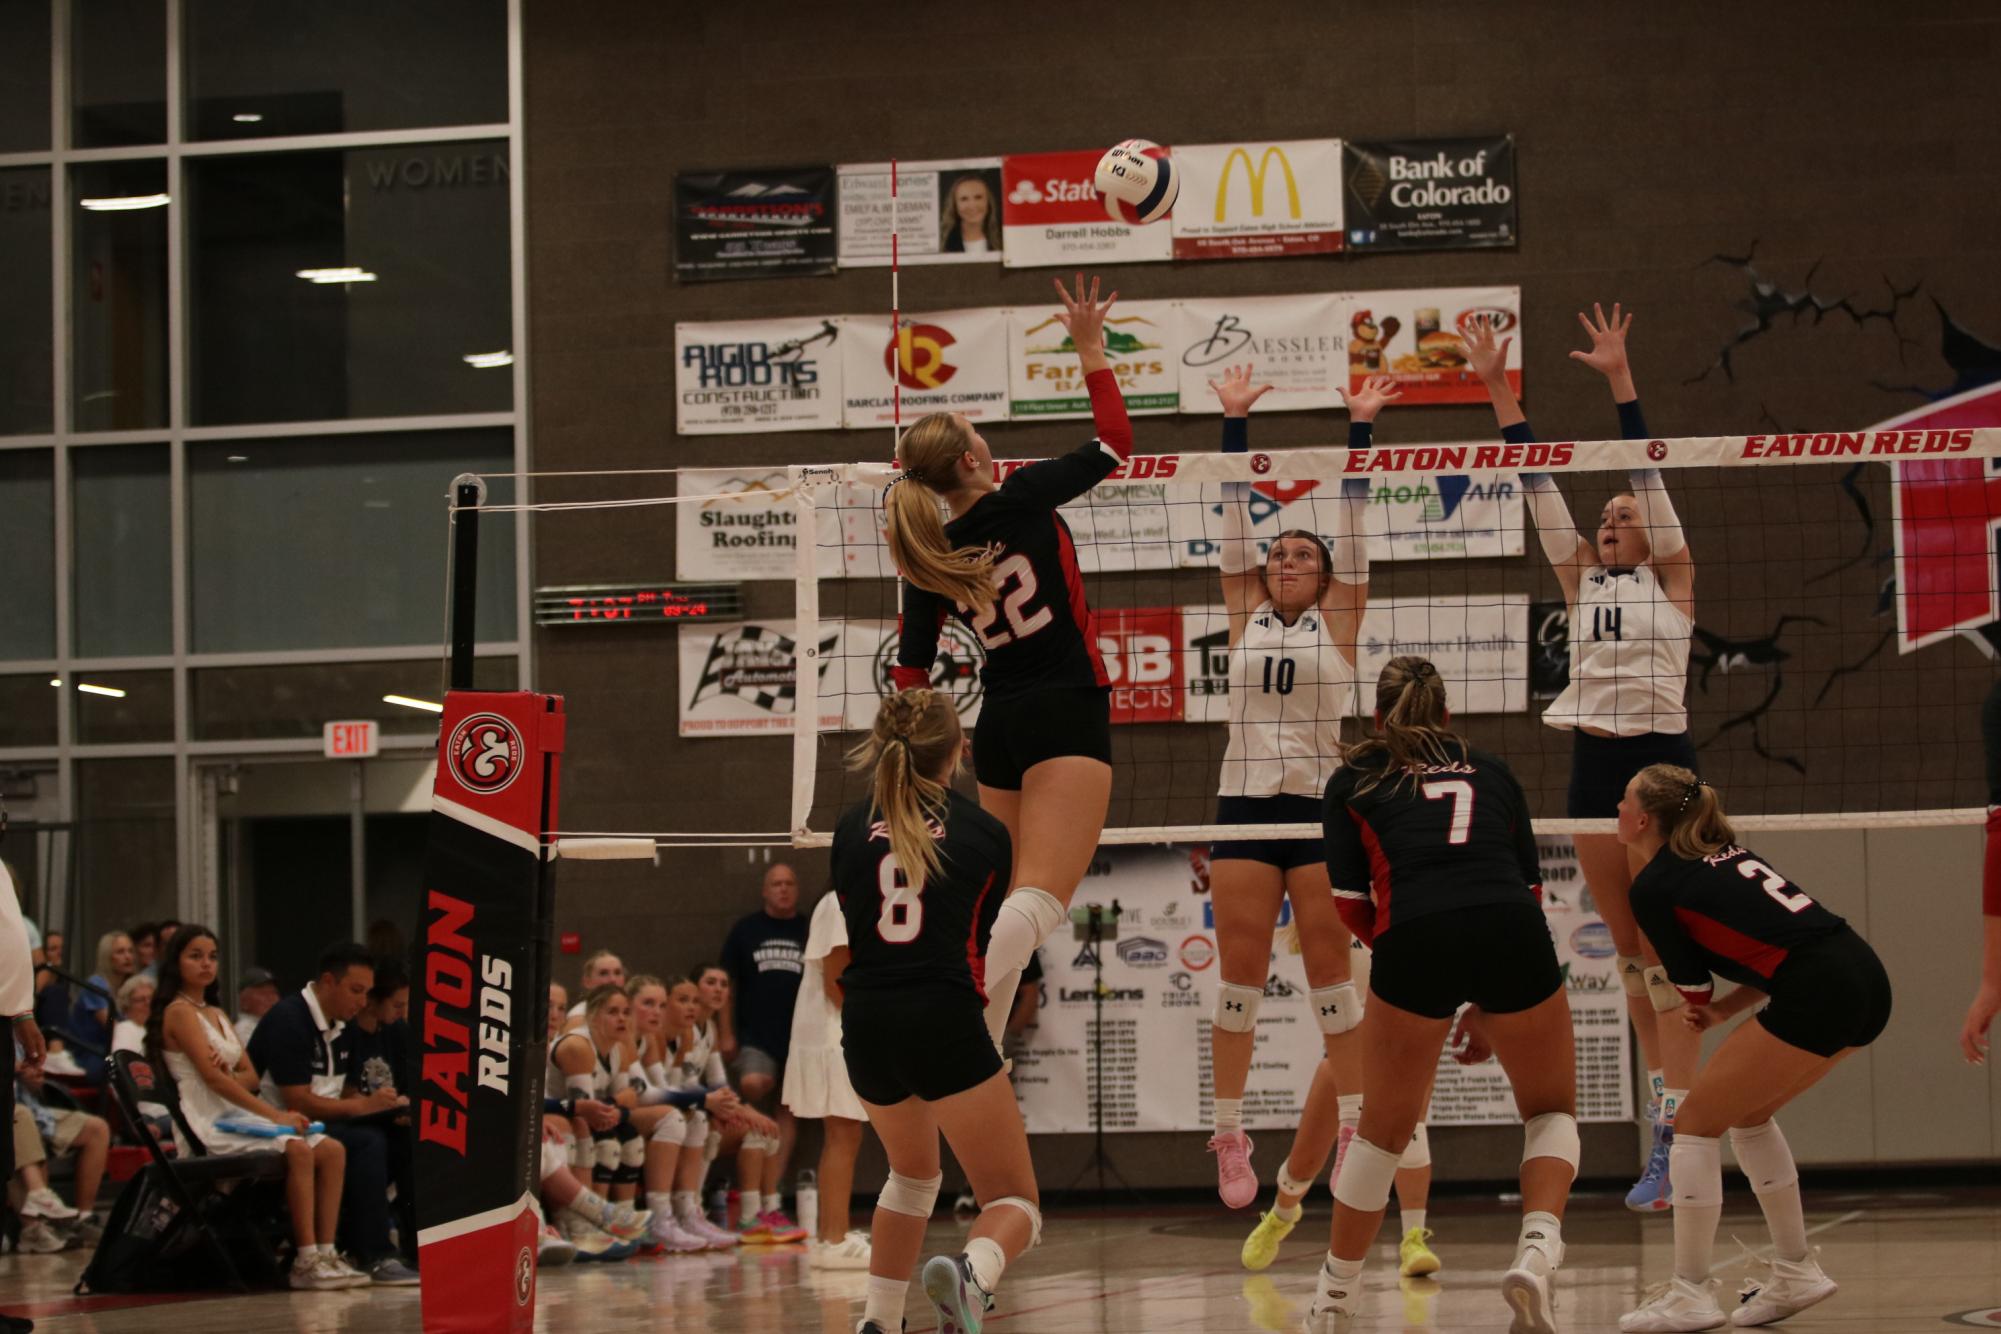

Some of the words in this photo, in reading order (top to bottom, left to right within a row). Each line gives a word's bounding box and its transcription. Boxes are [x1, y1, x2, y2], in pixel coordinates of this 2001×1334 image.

[366, 152, 509, 190] WOMEN
[1389, 152, 1455, 180] Bank
[1458, 150, 1487, 177] of
[0, 181, 48, 211] EN
[1390, 178, 1511, 208] Colorado
[1046, 227, 1087, 240] Darrell
[1090, 225, 1131, 238] Hobbs
[683, 342, 769, 369] RIGID
[698, 360, 818, 389] ROOTS
[1026, 361, 1164, 381] Farers
[682, 387, 820, 406] CONSTRUCTION
[951, 391, 1005, 404] COMPANY
[1343, 444, 1470, 473] EATON
[1471, 442, 1575, 470] REDS
[1740, 433, 1866, 459] EATON
[1869, 429, 1974, 455] REDS
[1103, 455, 1180, 480] EDS
[1081, 485, 1166, 500] NDVIEW
[1466, 482, 1514, 502] AIR
[957, 552, 1054, 651] 22
[1593, 606, 1622, 642] 14
[1262, 655, 1296, 696] 10
[332, 723, 369, 754] EXIT
[453, 729, 468, 756] EATON
[1421, 777, 1476, 847] 7
[1539, 867, 1578, 882] ROUP
[1735, 858, 1815, 916] 2
[875, 851, 929, 945] 8
[418, 888, 477, 1160] EATON
[477, 953, 513, 1098] REDS
